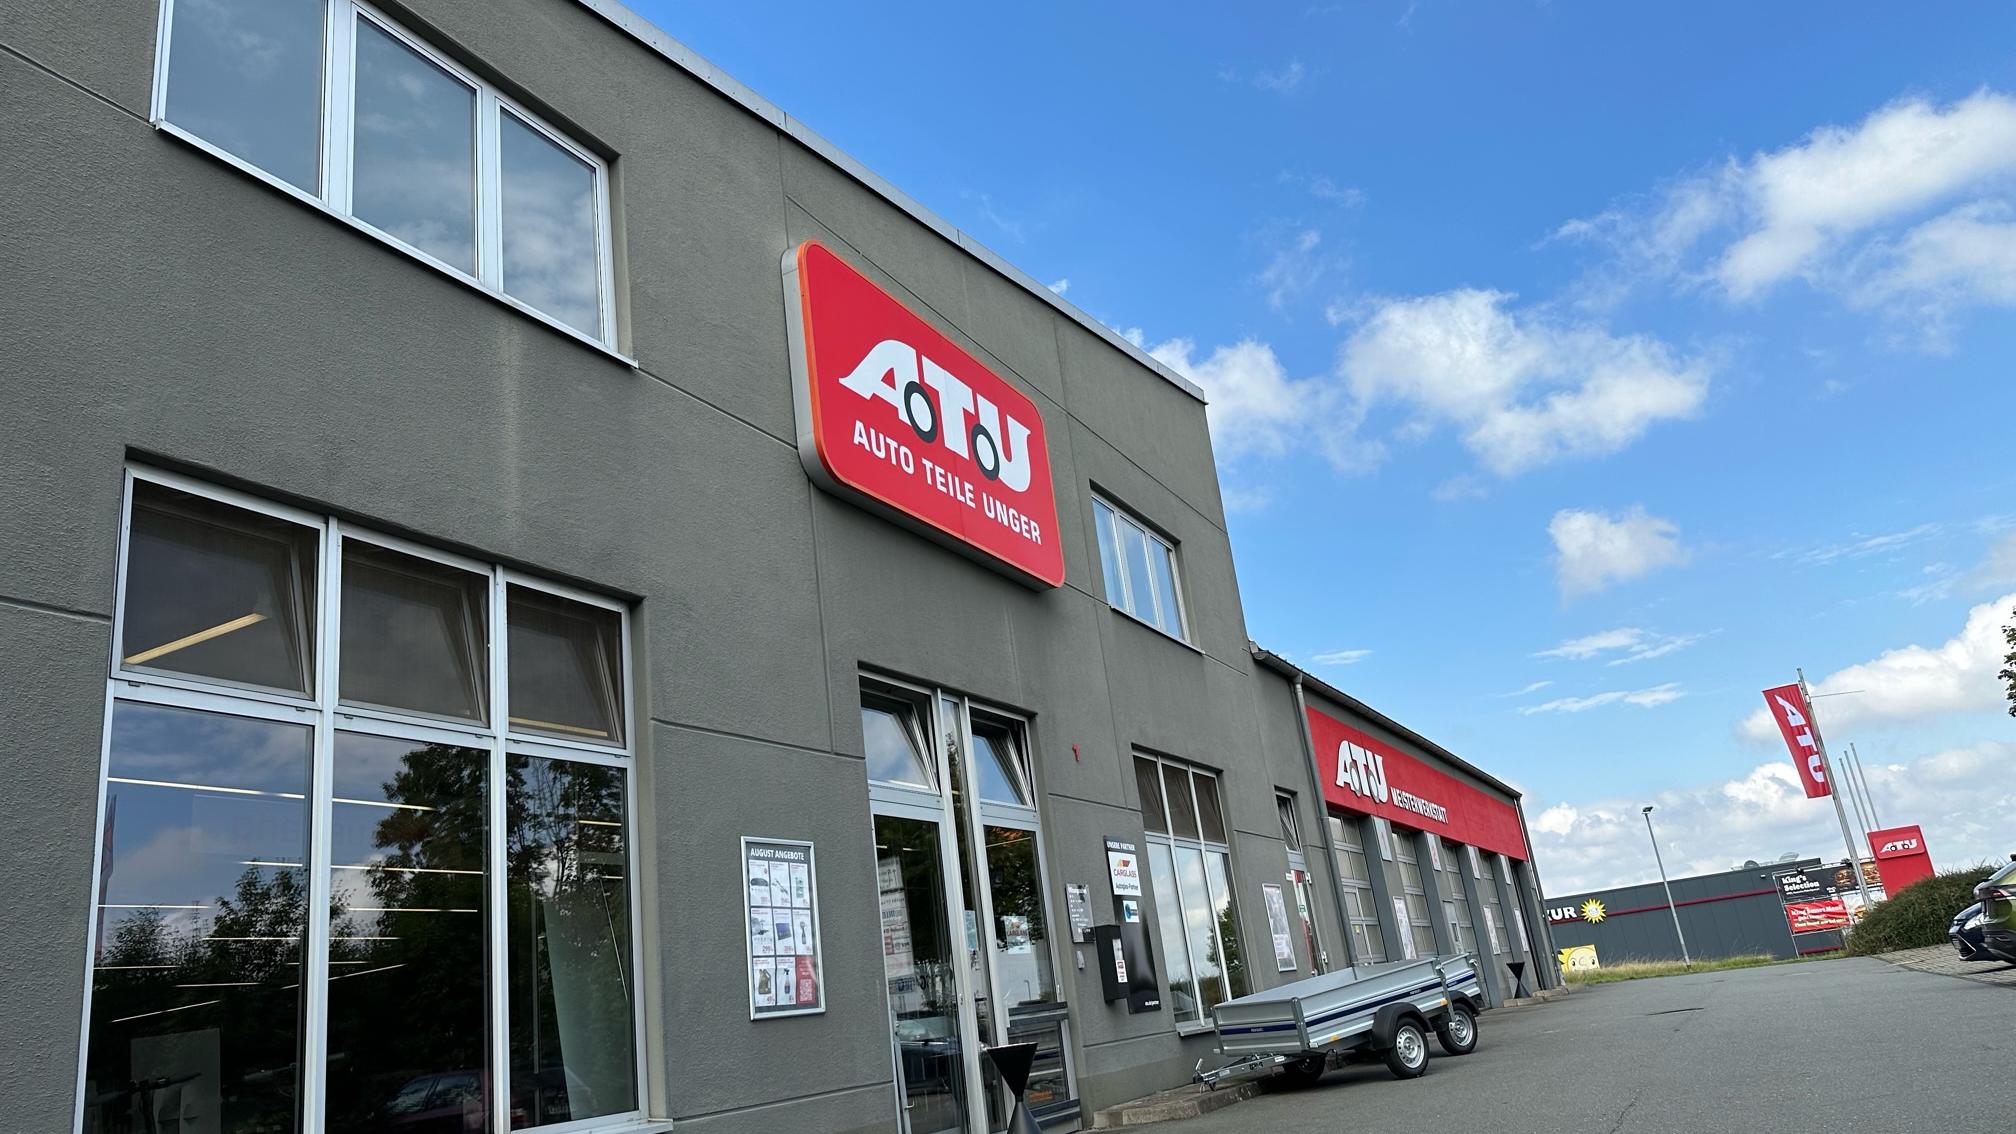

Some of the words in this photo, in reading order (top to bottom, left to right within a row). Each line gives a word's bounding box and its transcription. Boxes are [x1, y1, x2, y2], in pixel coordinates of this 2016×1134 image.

[839, 340, 1031, 492] ATU
[853, 420, 914, 475] AUTO
[921, 458, 976, 508] TEILE
[983, 492, 1041, 545] UNGER
[1775, 695, 1825, 783] ATU
[1336, 740, 1388, 804] ATU
[751, 848, 774, 858] AUGUST
[775, 850, 805, 860] ANGEBOTE
[1880, 839, 1917, 853] ATU
[1782, 875, 1807, 884] King's
[1784, 881, 1820, 892] Selection
